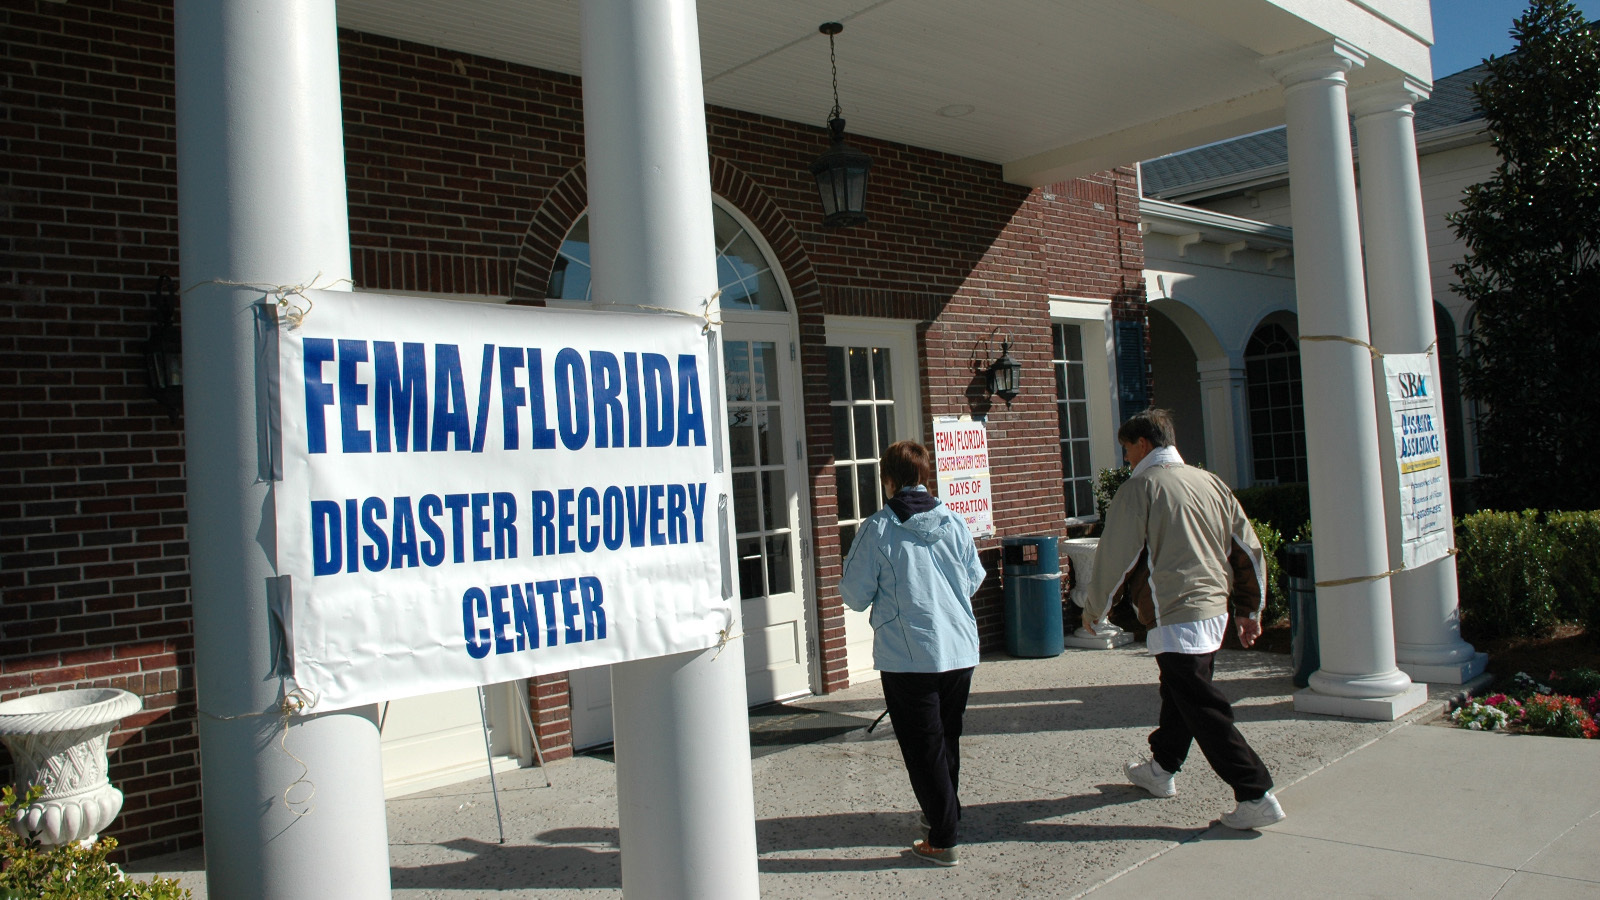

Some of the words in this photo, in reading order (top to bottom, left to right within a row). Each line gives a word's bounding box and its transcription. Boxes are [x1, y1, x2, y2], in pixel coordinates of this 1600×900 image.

[302, 337, 707, 454] FEMA/FLORIDA
[1399, 373, 1428, 398] SBA
[936, 430, 985, 454] FEMA/FLORIDA
[938, 457, 956, 472] DISASTER
[956, 455, 974, 471] RECOVERY
[974, 454, 987, 468] CENTER
[949, 481, 970, 496] DAYS
[971, 480, 981, 493] OF
[311, 491, 518, 577] DISASTER
[531, 482, 707, 557] RECOVERY
[462, 576, 607, 660] CENTER
